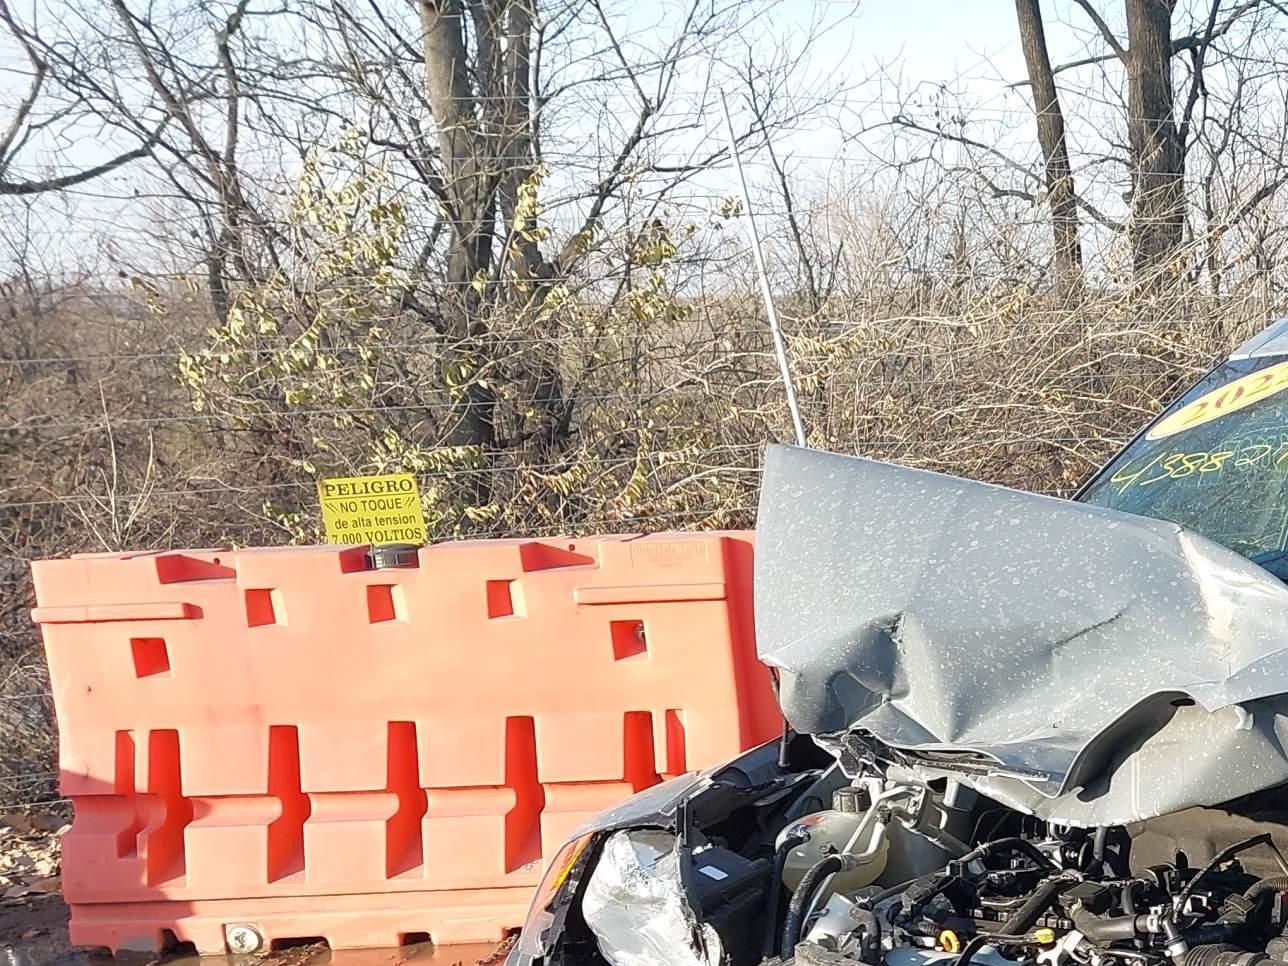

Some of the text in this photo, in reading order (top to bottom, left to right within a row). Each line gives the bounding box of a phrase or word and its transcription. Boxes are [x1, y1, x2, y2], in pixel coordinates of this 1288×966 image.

[324, 478, 413, 496] PELIGRO
[340, 497, 403, 513] NO TOQUE
[334, 513, 416, 530] de alta tension
[365, 527, 423, 543] VOLTIOS
